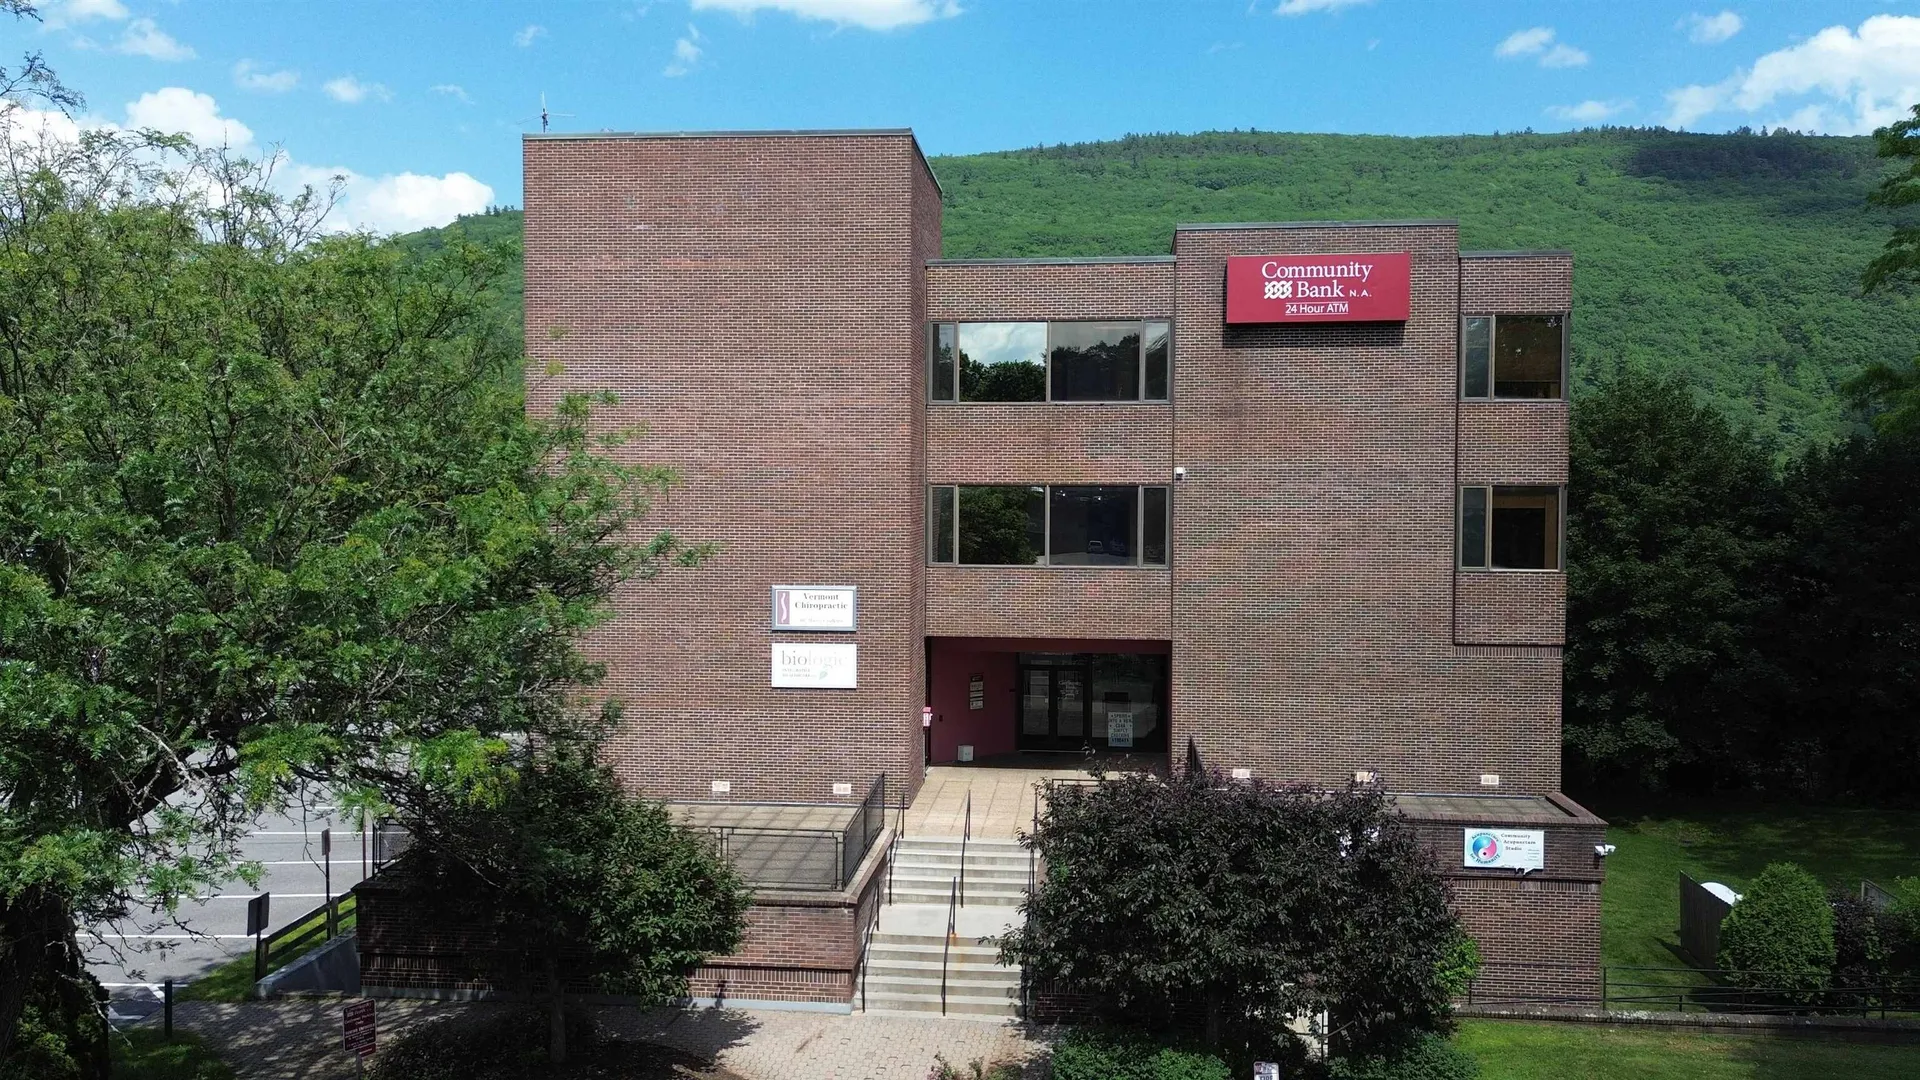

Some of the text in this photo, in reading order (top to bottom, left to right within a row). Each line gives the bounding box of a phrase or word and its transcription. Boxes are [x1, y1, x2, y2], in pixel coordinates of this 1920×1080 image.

[1261, 261, 1373, 283] Community
[1296, 280, 1372, 298] Bank N.A.
[1285, 302, 1349, 314] 24 Hour ATM
[803, 592, 839, 600] Vermont
[794, 601, 848, 610] Chiropractic
